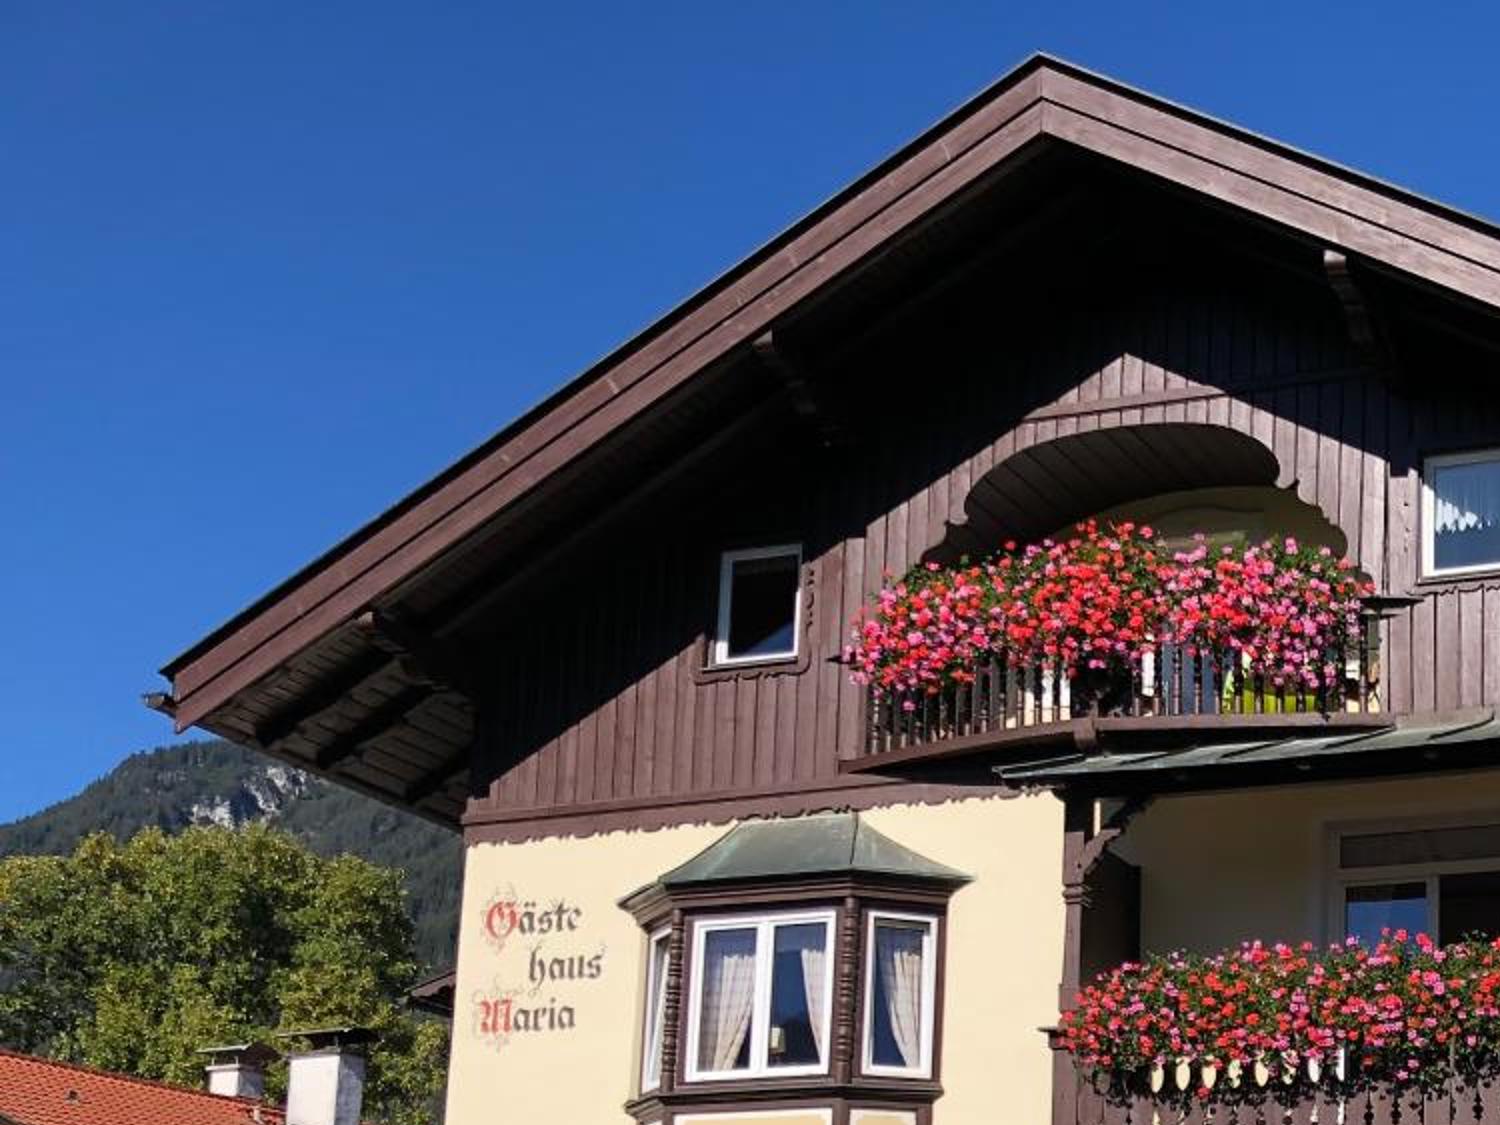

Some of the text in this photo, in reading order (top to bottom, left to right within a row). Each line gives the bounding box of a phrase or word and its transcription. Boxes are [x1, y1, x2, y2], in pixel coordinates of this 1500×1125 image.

[485, 898, 582, 940] Gäste
[528, 945, 604, 995] haus
[479, 996, 576, 1034] Maria
